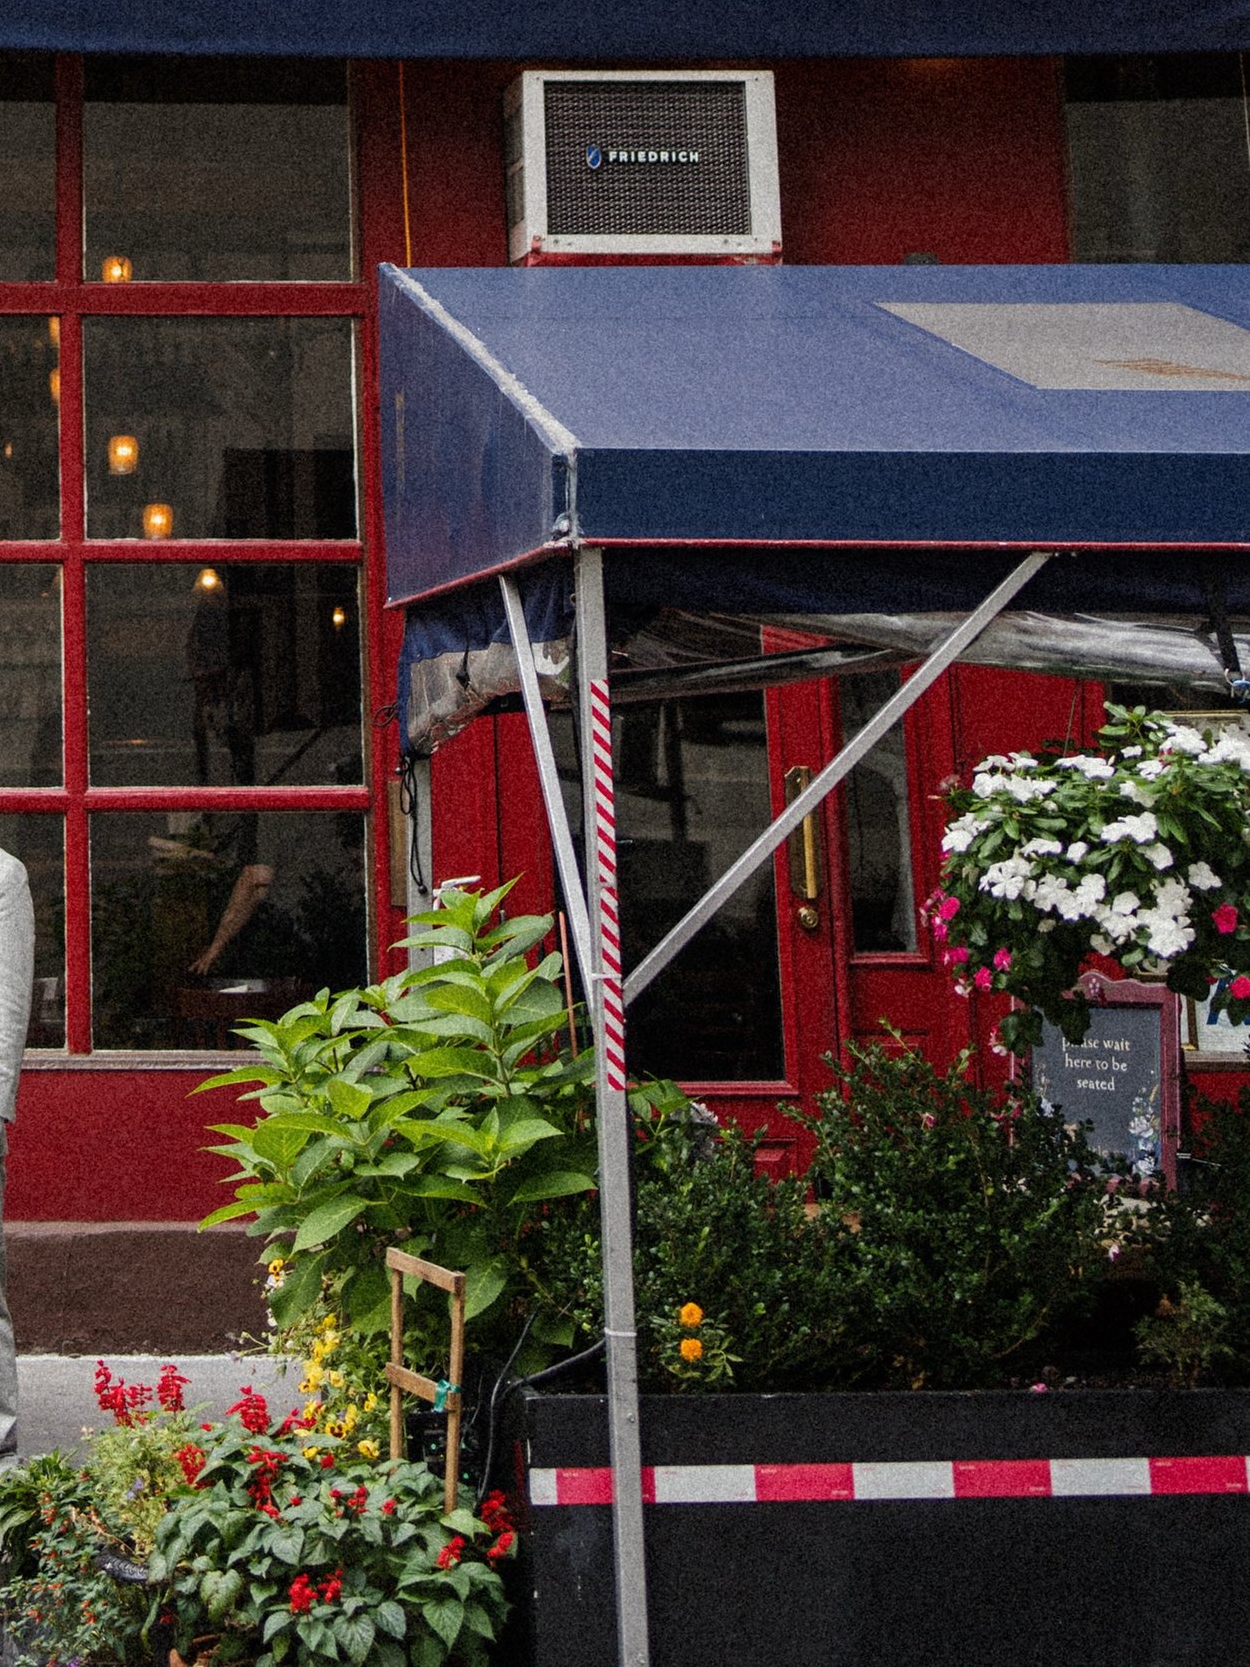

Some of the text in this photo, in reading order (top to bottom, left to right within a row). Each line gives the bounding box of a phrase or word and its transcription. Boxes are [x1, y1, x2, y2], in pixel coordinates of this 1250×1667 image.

[608, 150, 700, 163] FRIEDRICH
[1061, 1036, 1131, 1052] pase wait
[1065, 1053, 1128, 1072] here to be
[1076, 1076, 1116, 1091] seated
